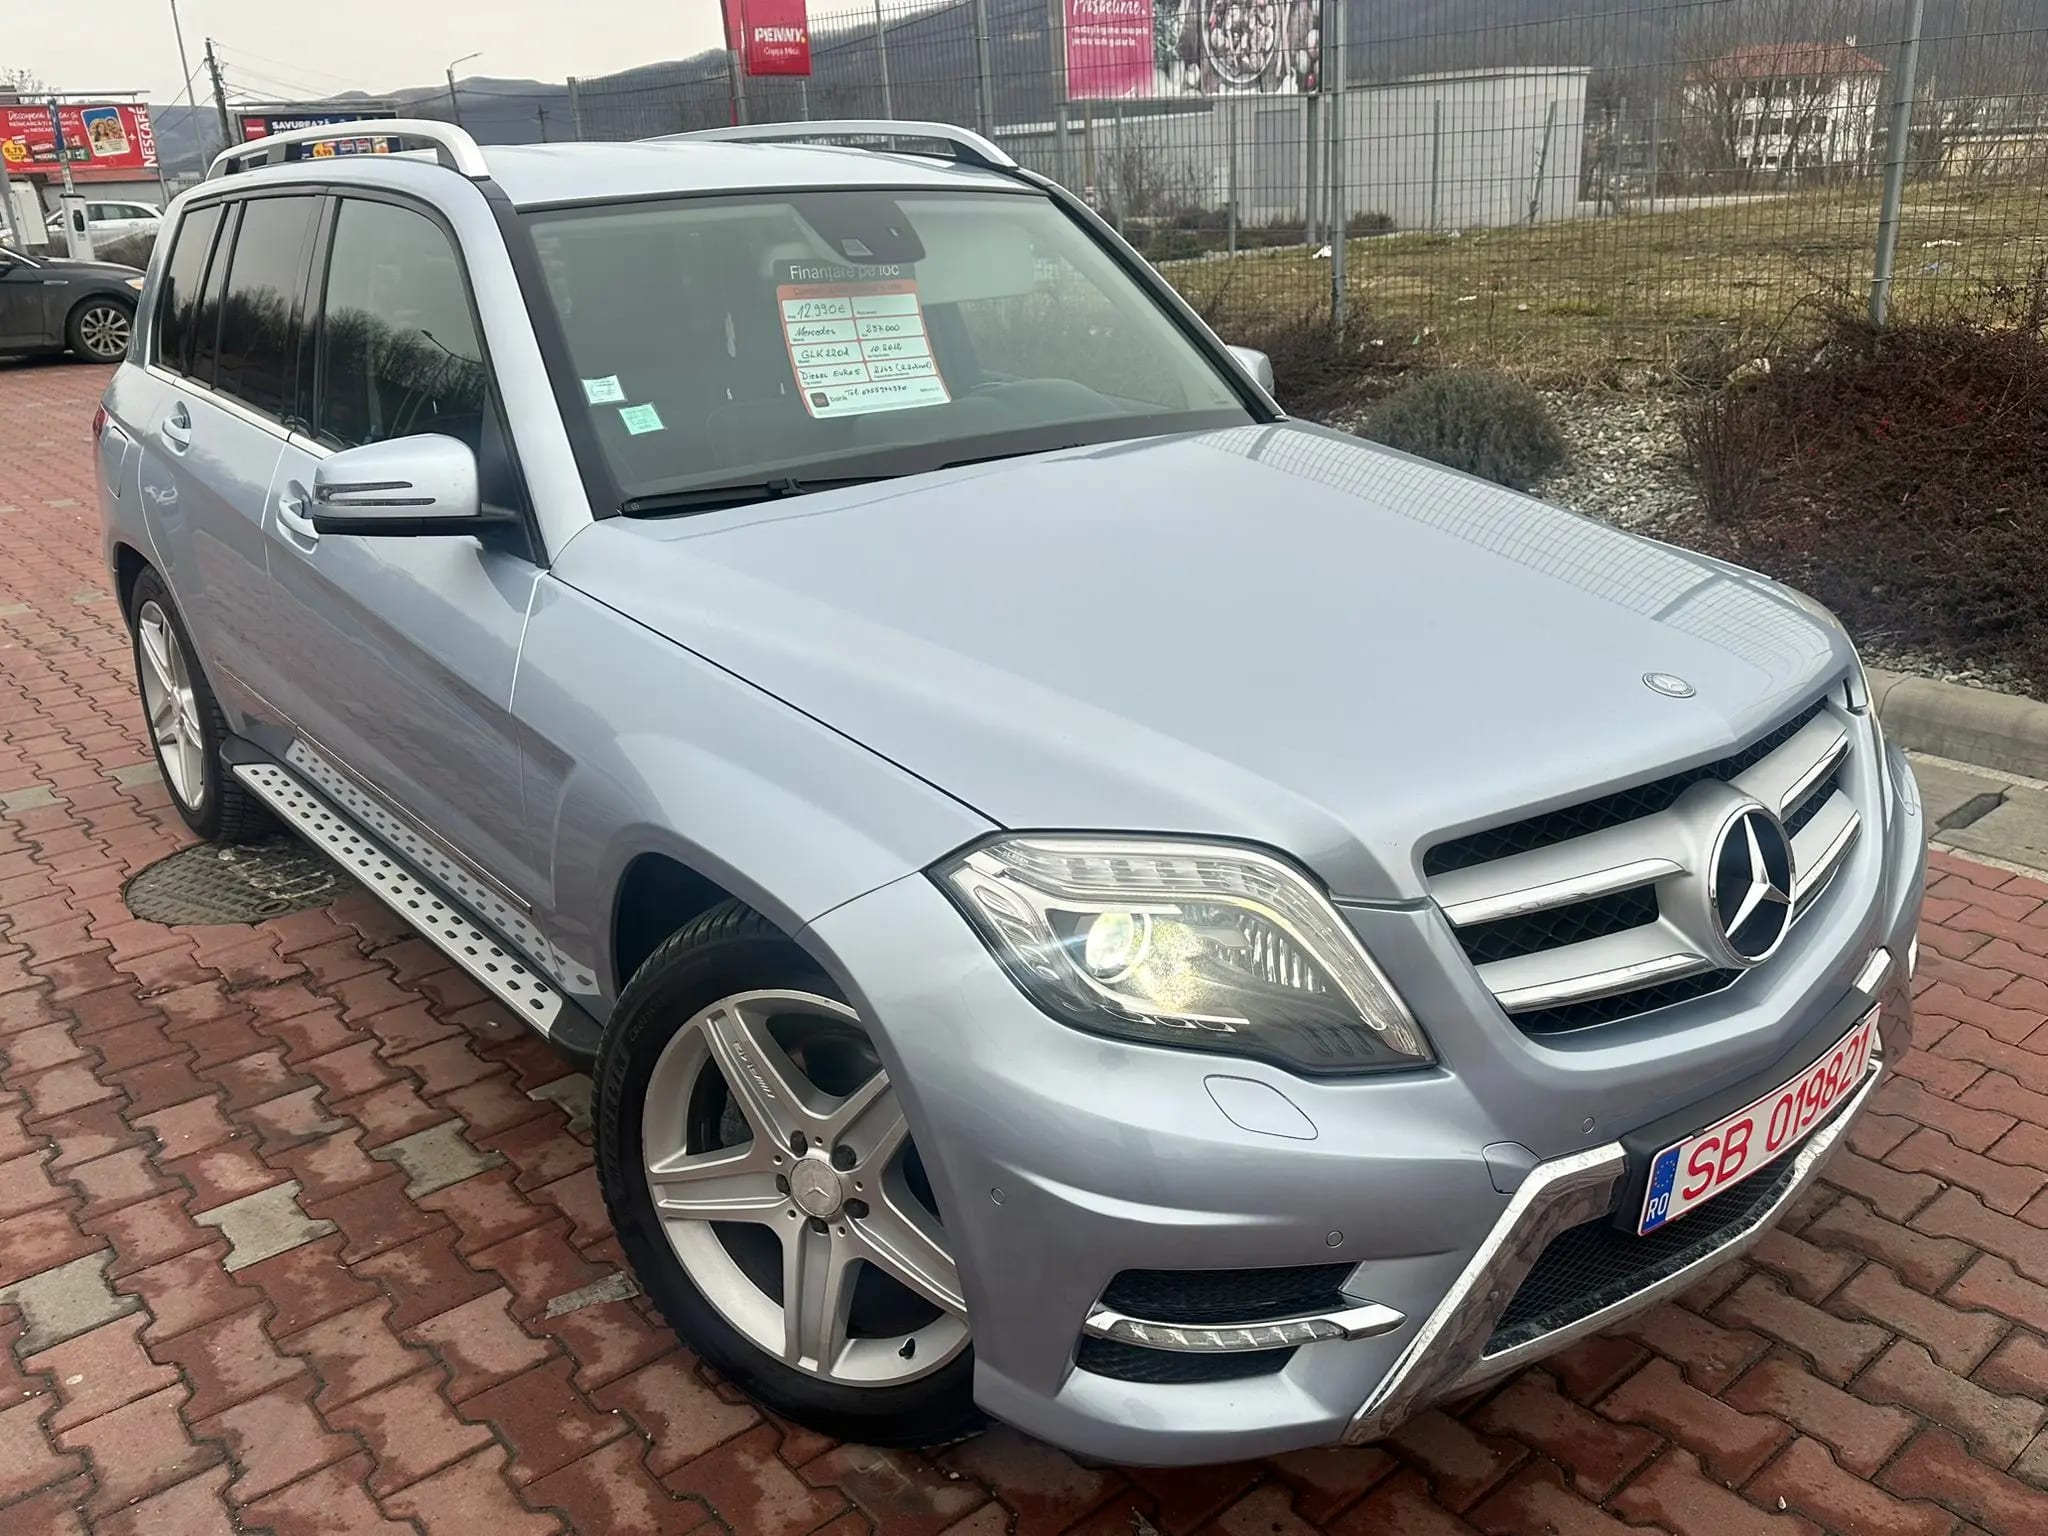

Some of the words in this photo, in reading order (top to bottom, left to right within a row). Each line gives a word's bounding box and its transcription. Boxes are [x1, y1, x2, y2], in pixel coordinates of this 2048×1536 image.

[129, 104, 158, 167] NESCAFÉ
[1682, 1117, 1754, 1201] SB
[1765, 1022, 1871, 1152] 019821
[1645, 1191, 1670, 1223] RO
